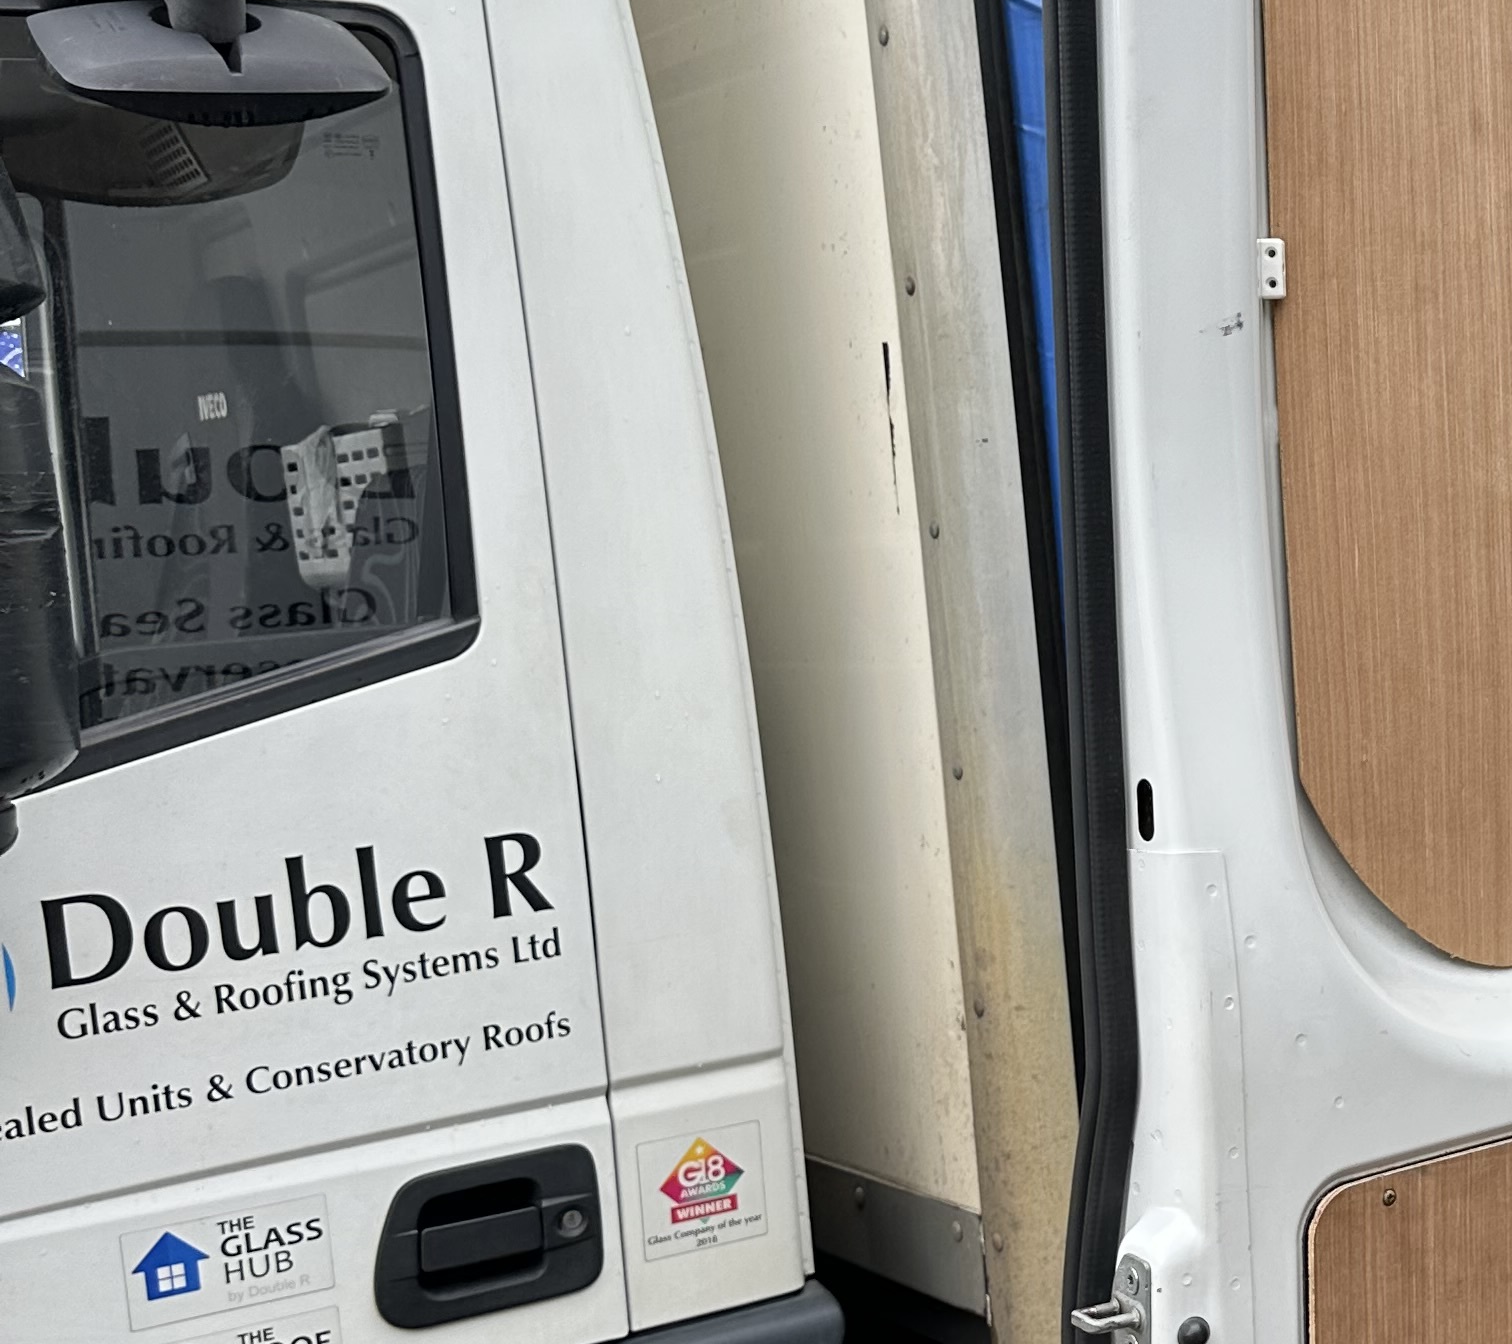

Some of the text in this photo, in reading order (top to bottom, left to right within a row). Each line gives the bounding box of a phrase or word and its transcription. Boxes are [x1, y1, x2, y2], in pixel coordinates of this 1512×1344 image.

[198, 392, 227, 421] IVECO
[41, 831, 555, 990] Double R
[57, 926, 562, 1040] Glass & Roofing Systems Ltd
[0, 1010, 572, 1141] aled Units & Conservatory Roofs
[680, 1180, 727, 1199] AWARDS
[217, 1215, 256, 1236] THE
[676, 1198, 732, 1220] WINNER
[220, 1218, 323, 1258] GLASS
[647, 1213, 763, 1246] Glass Company of the year
[224, 1249, 294, 1285] HUB
[227, 1273, 312, 1304] by Double R
